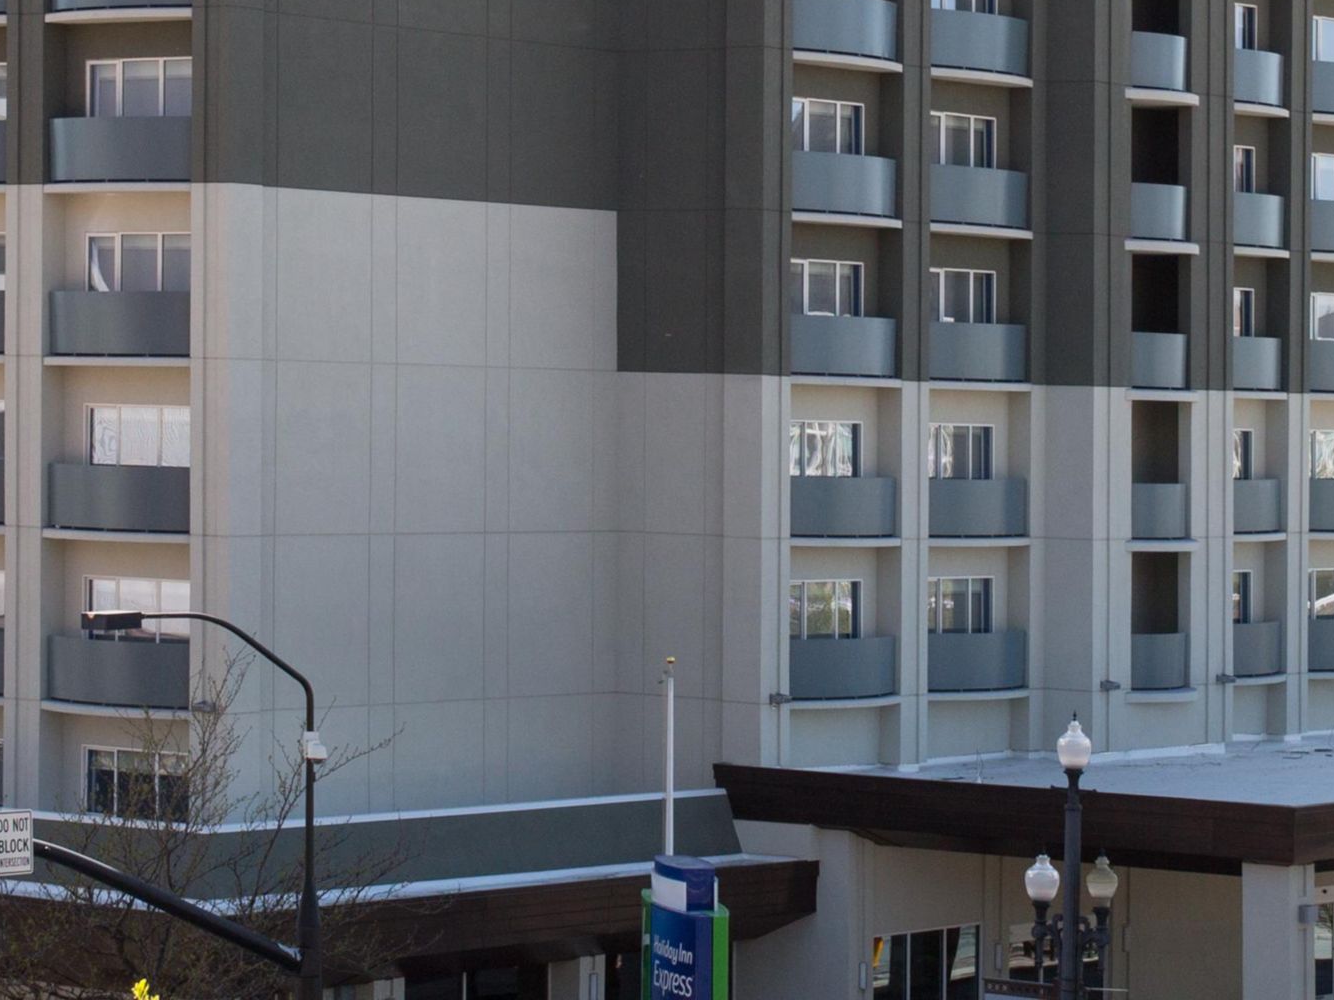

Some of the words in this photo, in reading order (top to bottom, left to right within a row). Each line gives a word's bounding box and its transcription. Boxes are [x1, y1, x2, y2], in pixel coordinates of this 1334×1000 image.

[12, 817, 29, 832] NOT
[653, 935, 678, 965] Holiday
[678, 942, 693, 964] Inn
[653, 959, 694, 997] Express
